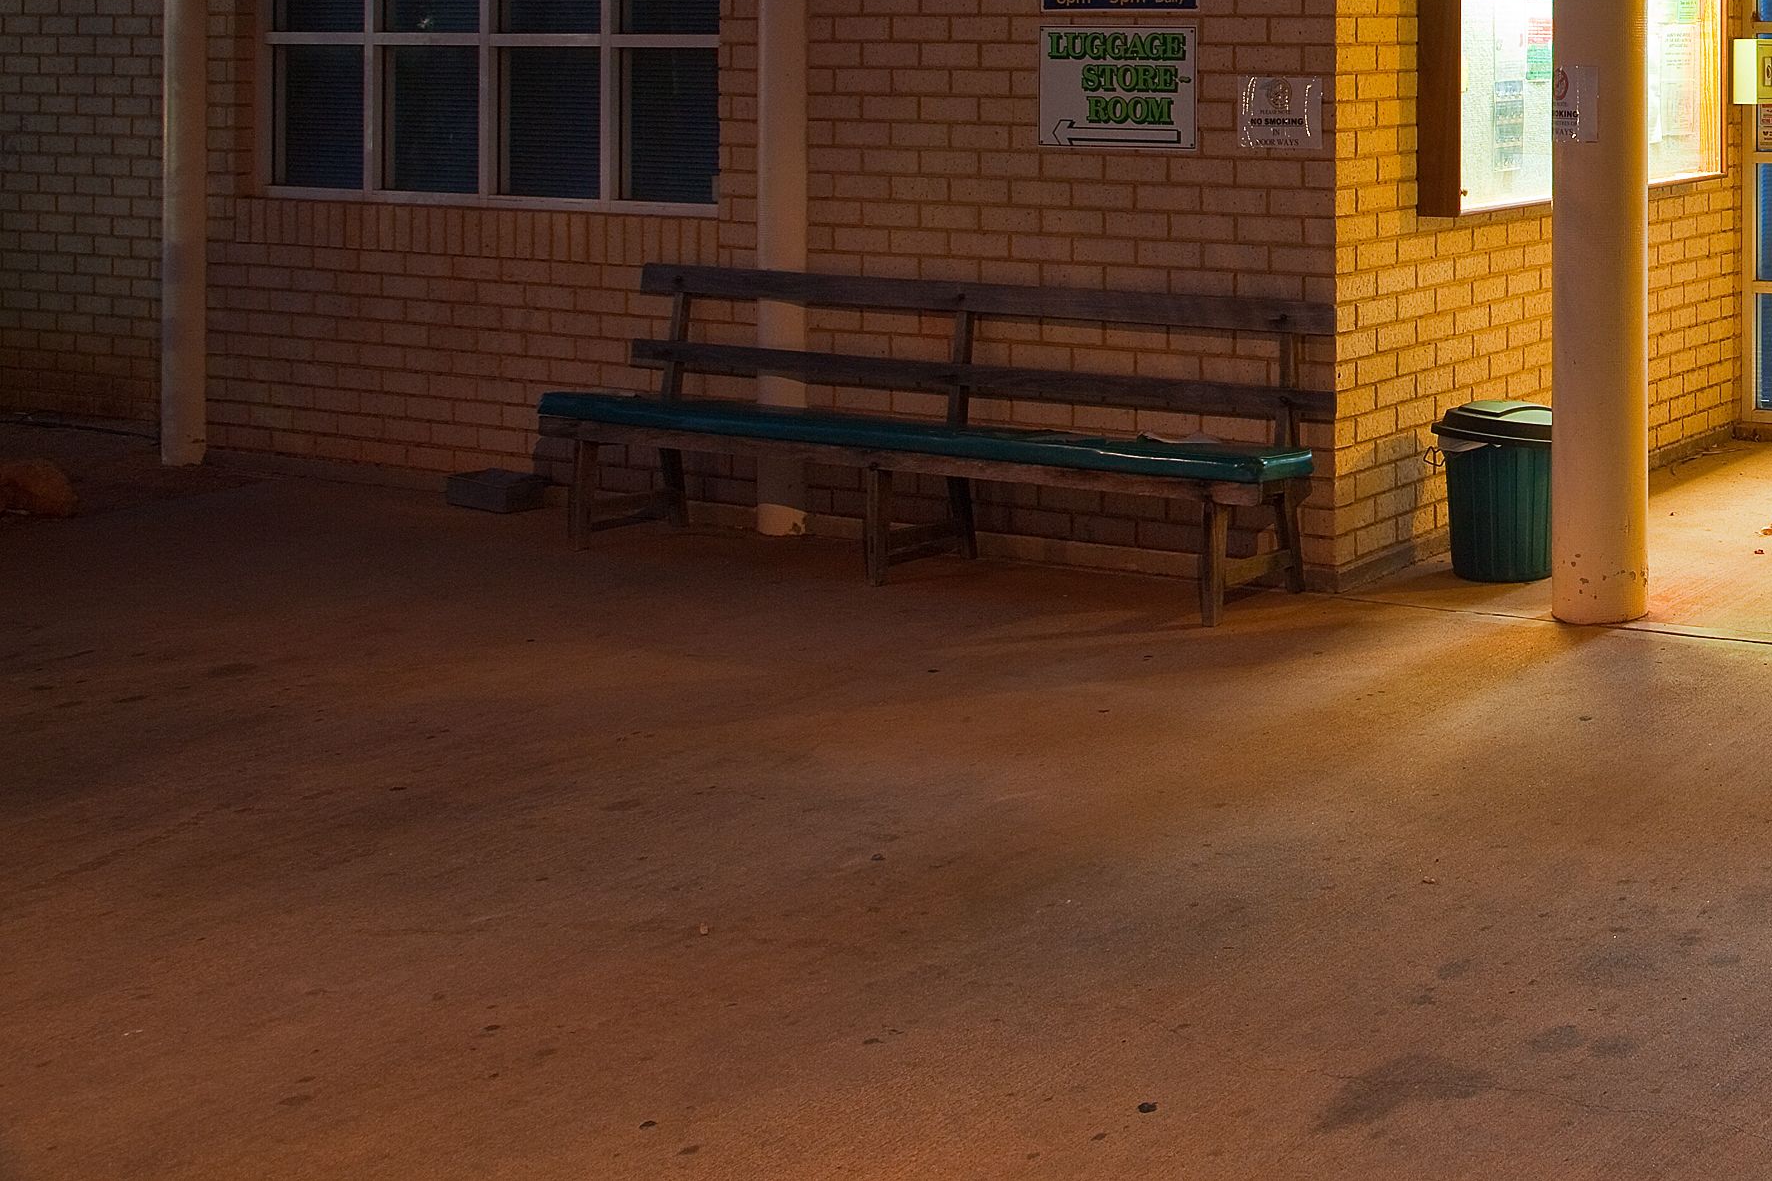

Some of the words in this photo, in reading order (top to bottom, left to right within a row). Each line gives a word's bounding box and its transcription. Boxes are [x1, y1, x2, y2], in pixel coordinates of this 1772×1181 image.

[1048, 32, 1186, 61] LUGGAGE
[1086, 96, 1174, 125] ROOM
[1265, 118, 1304, 126] SMOKING
